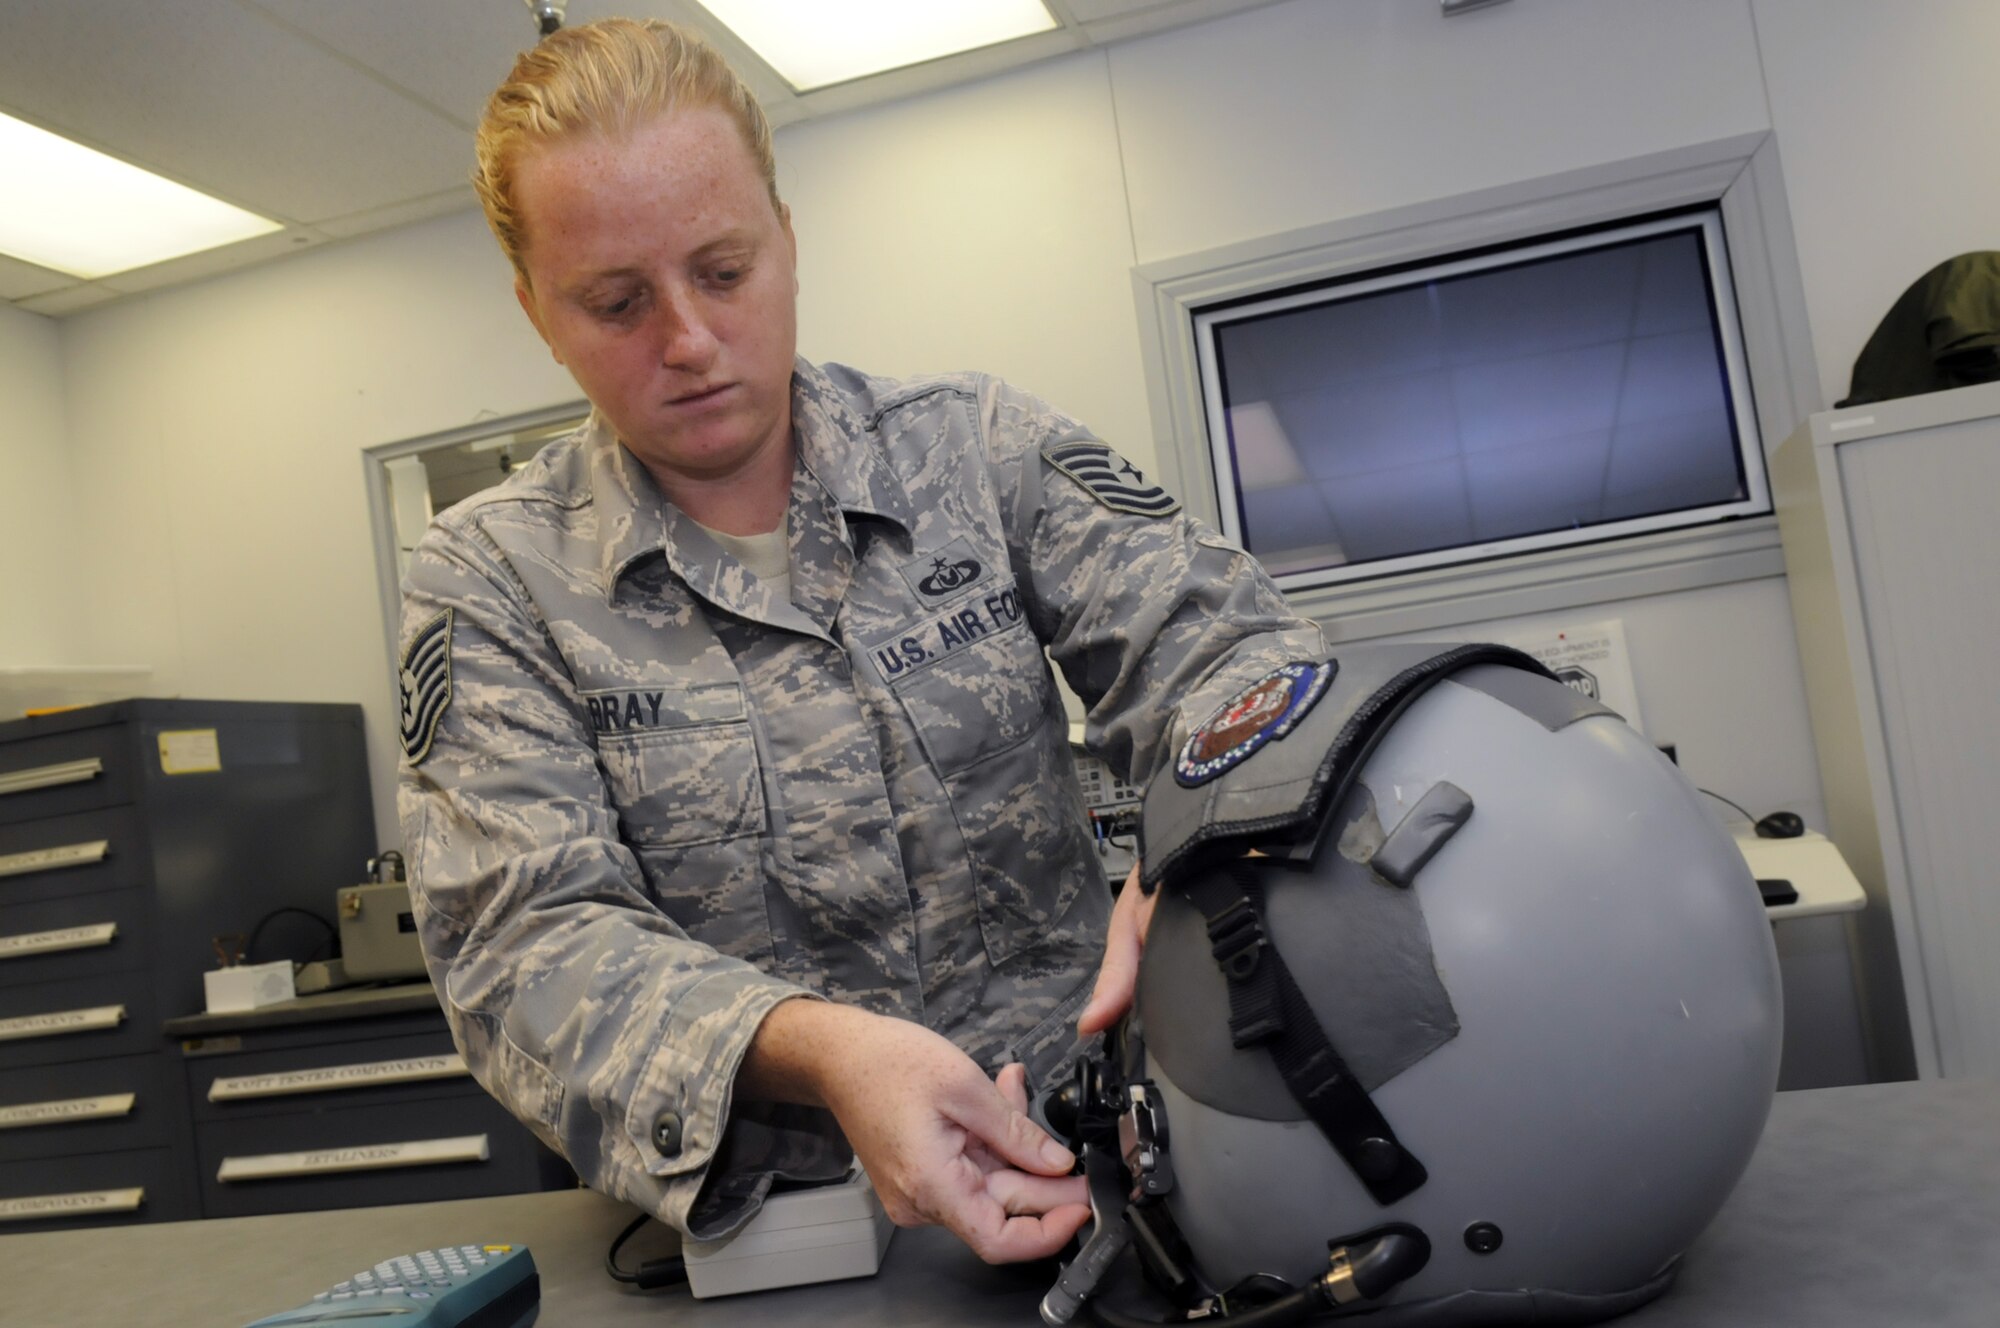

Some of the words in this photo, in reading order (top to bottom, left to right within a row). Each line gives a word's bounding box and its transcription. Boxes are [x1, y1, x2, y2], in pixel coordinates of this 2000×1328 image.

[877, 637, 935, 674] U.S.
[937, 608, 987, 651] AIR
[1545, 640, 1600, 657] EQUIPMENT
[586, 692, 664, 730] BRAY
[225, 1077, 274, 1091] SCOTT
[278, 1070, 337, 1087] TESTER
[339, 1059, 448, 1079] COMPONENTS
[5, 1102, 98, 1119] COMPONENTS
[12, 1196, 108, 1211] COMPONENTS
